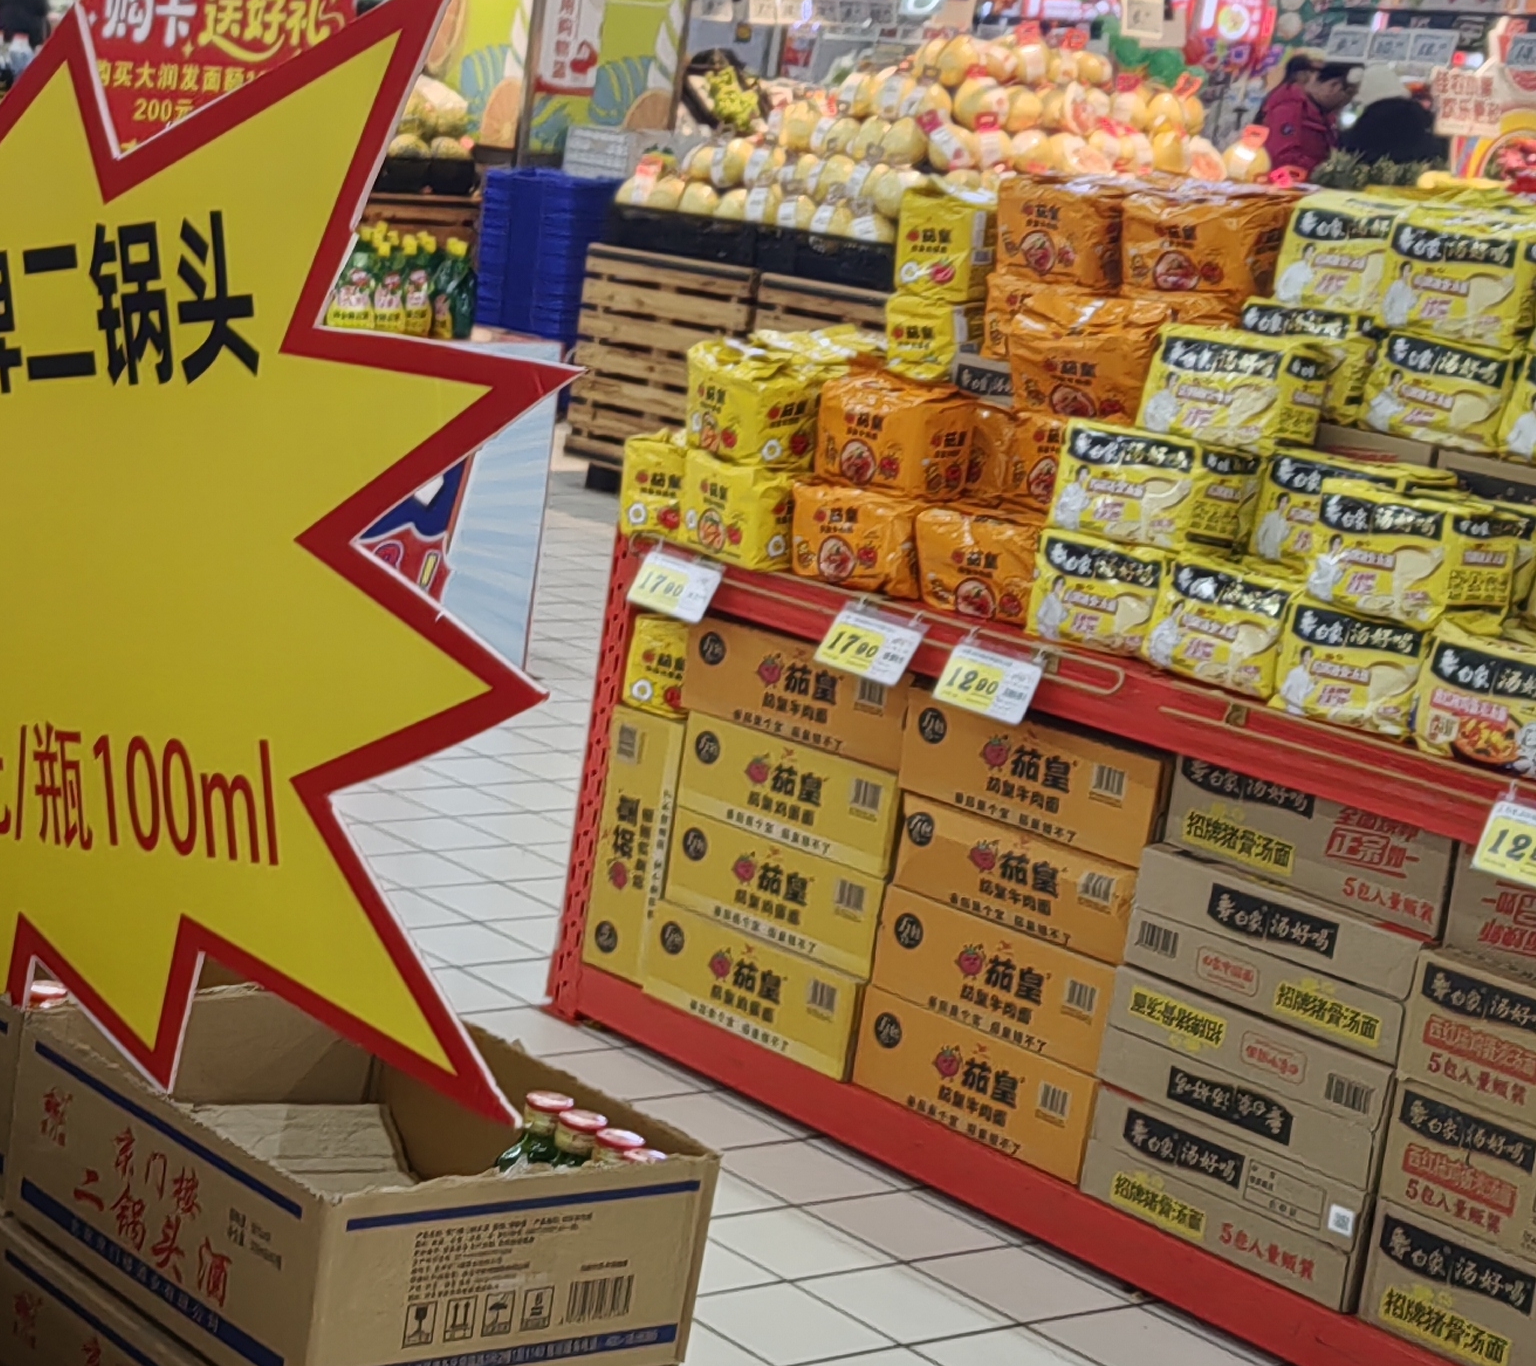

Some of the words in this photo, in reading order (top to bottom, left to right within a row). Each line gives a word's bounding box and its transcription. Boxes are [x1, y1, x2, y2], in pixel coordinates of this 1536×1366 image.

[784, 661, 839, 706] 茄皇
[770, 764, 824, 807] 茄皇
[1010, 744, 1072, 794] 茄皇
[1186, 811, 1294, 869] 招牌猪骨汤面
[757, 861, 810, 907] 茄皇
[999, 850, 1060, 899] 茄皇
[1269, 913, 1330, 952] 汤好喝
[732, 958, 783, 1005] 茄皇
[984, 954, 1045, 1007] 茄皇
[1275, 982, 1380, 1040] 招牌猪骨汤面
[961, 1057, 1020, 1110] 茄皇
[114, 1126, 202, 1221] 京门楼
[1180, 1142, 1236, 1183] 汤好喝
[72, 1168, 232, 1308] 二锅头酒
[1454, 1256, 1528, 1307] 汤好喝
[1385, 1287, 1509, 1364] 招牌猪骨汤面
